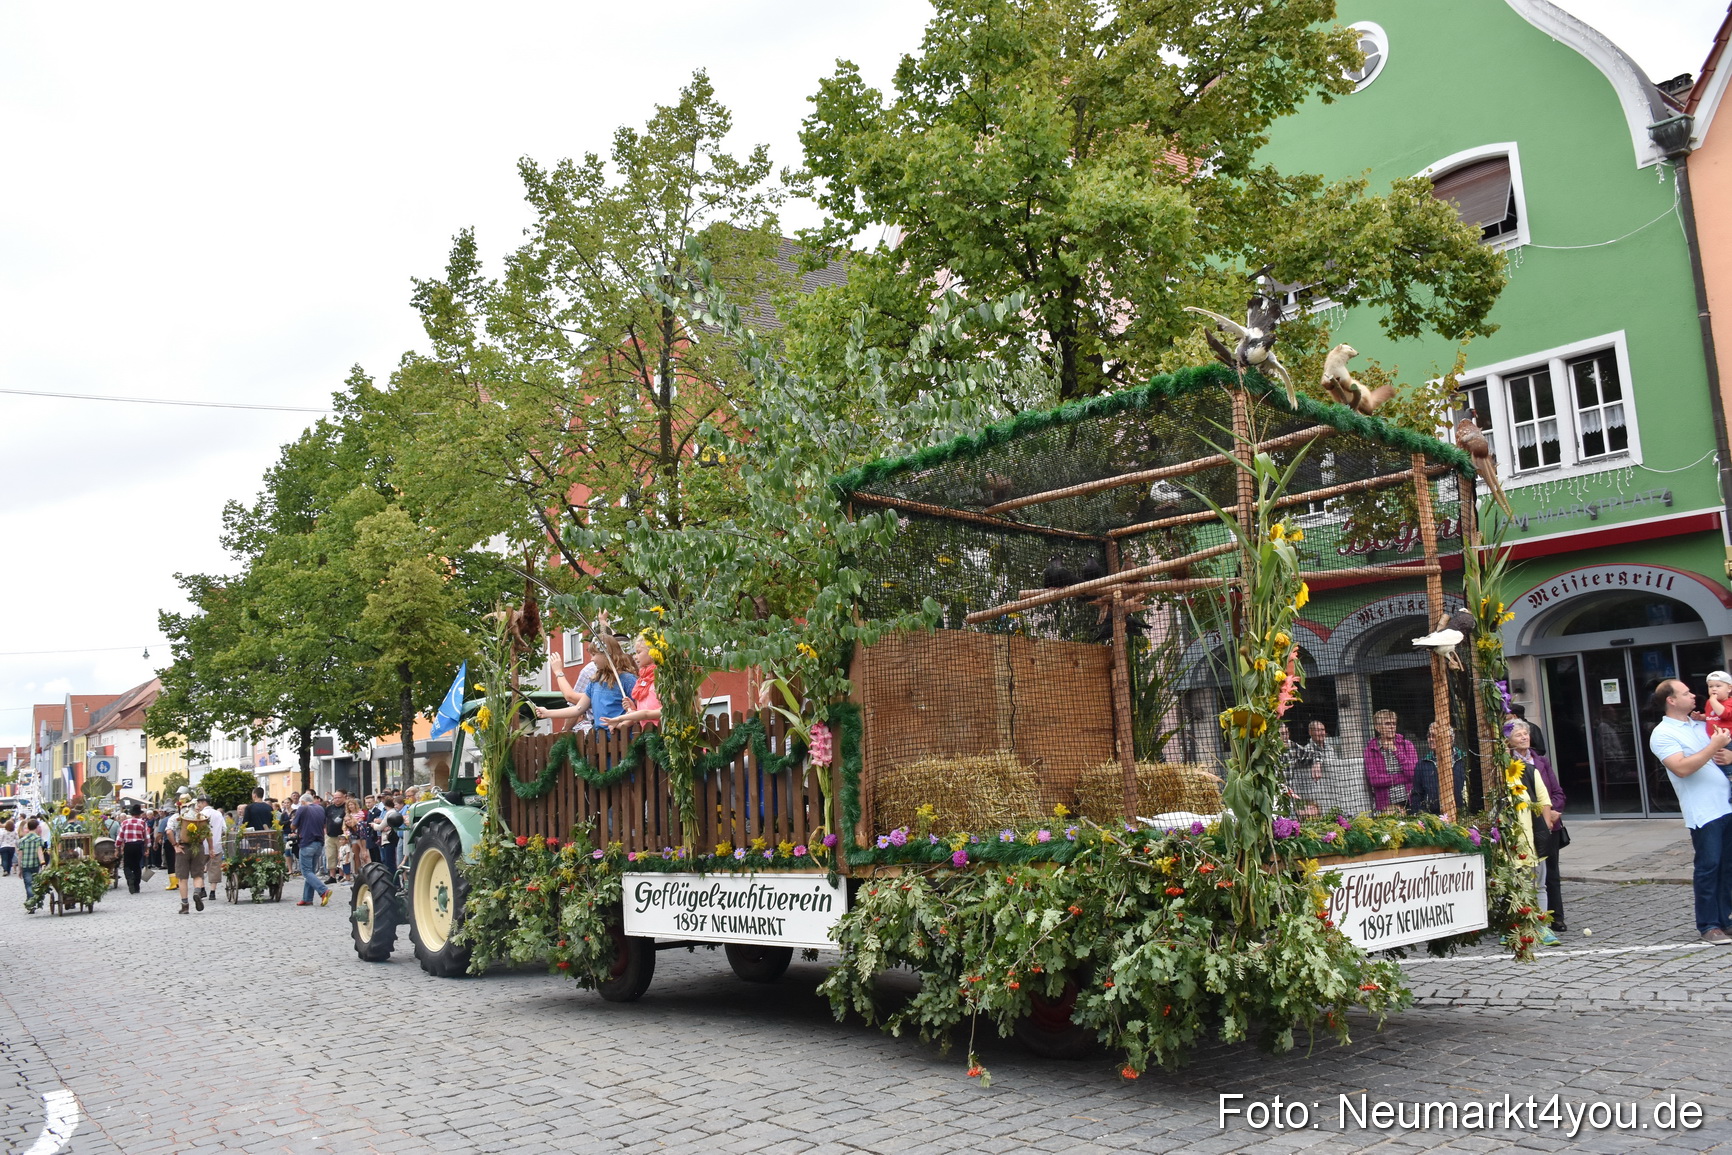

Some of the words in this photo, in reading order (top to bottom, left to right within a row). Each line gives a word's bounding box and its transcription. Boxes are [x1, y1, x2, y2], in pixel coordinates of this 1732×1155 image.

[1500, 512, 1530, 529] AM
[1536, 487, 1671, 525] MARKTPLATZ
[1357, 599, 1459, 626] Metzgeei
[634, 881, 832, 913] Geflügelzuchtverein
[673, 912, 707, 932] 1897
[711, 912, 786, 937] NEUMARKT
[1358, 914, 1393, 941] 1897
[1396, 903, 1455, 935] NEUMARKT
